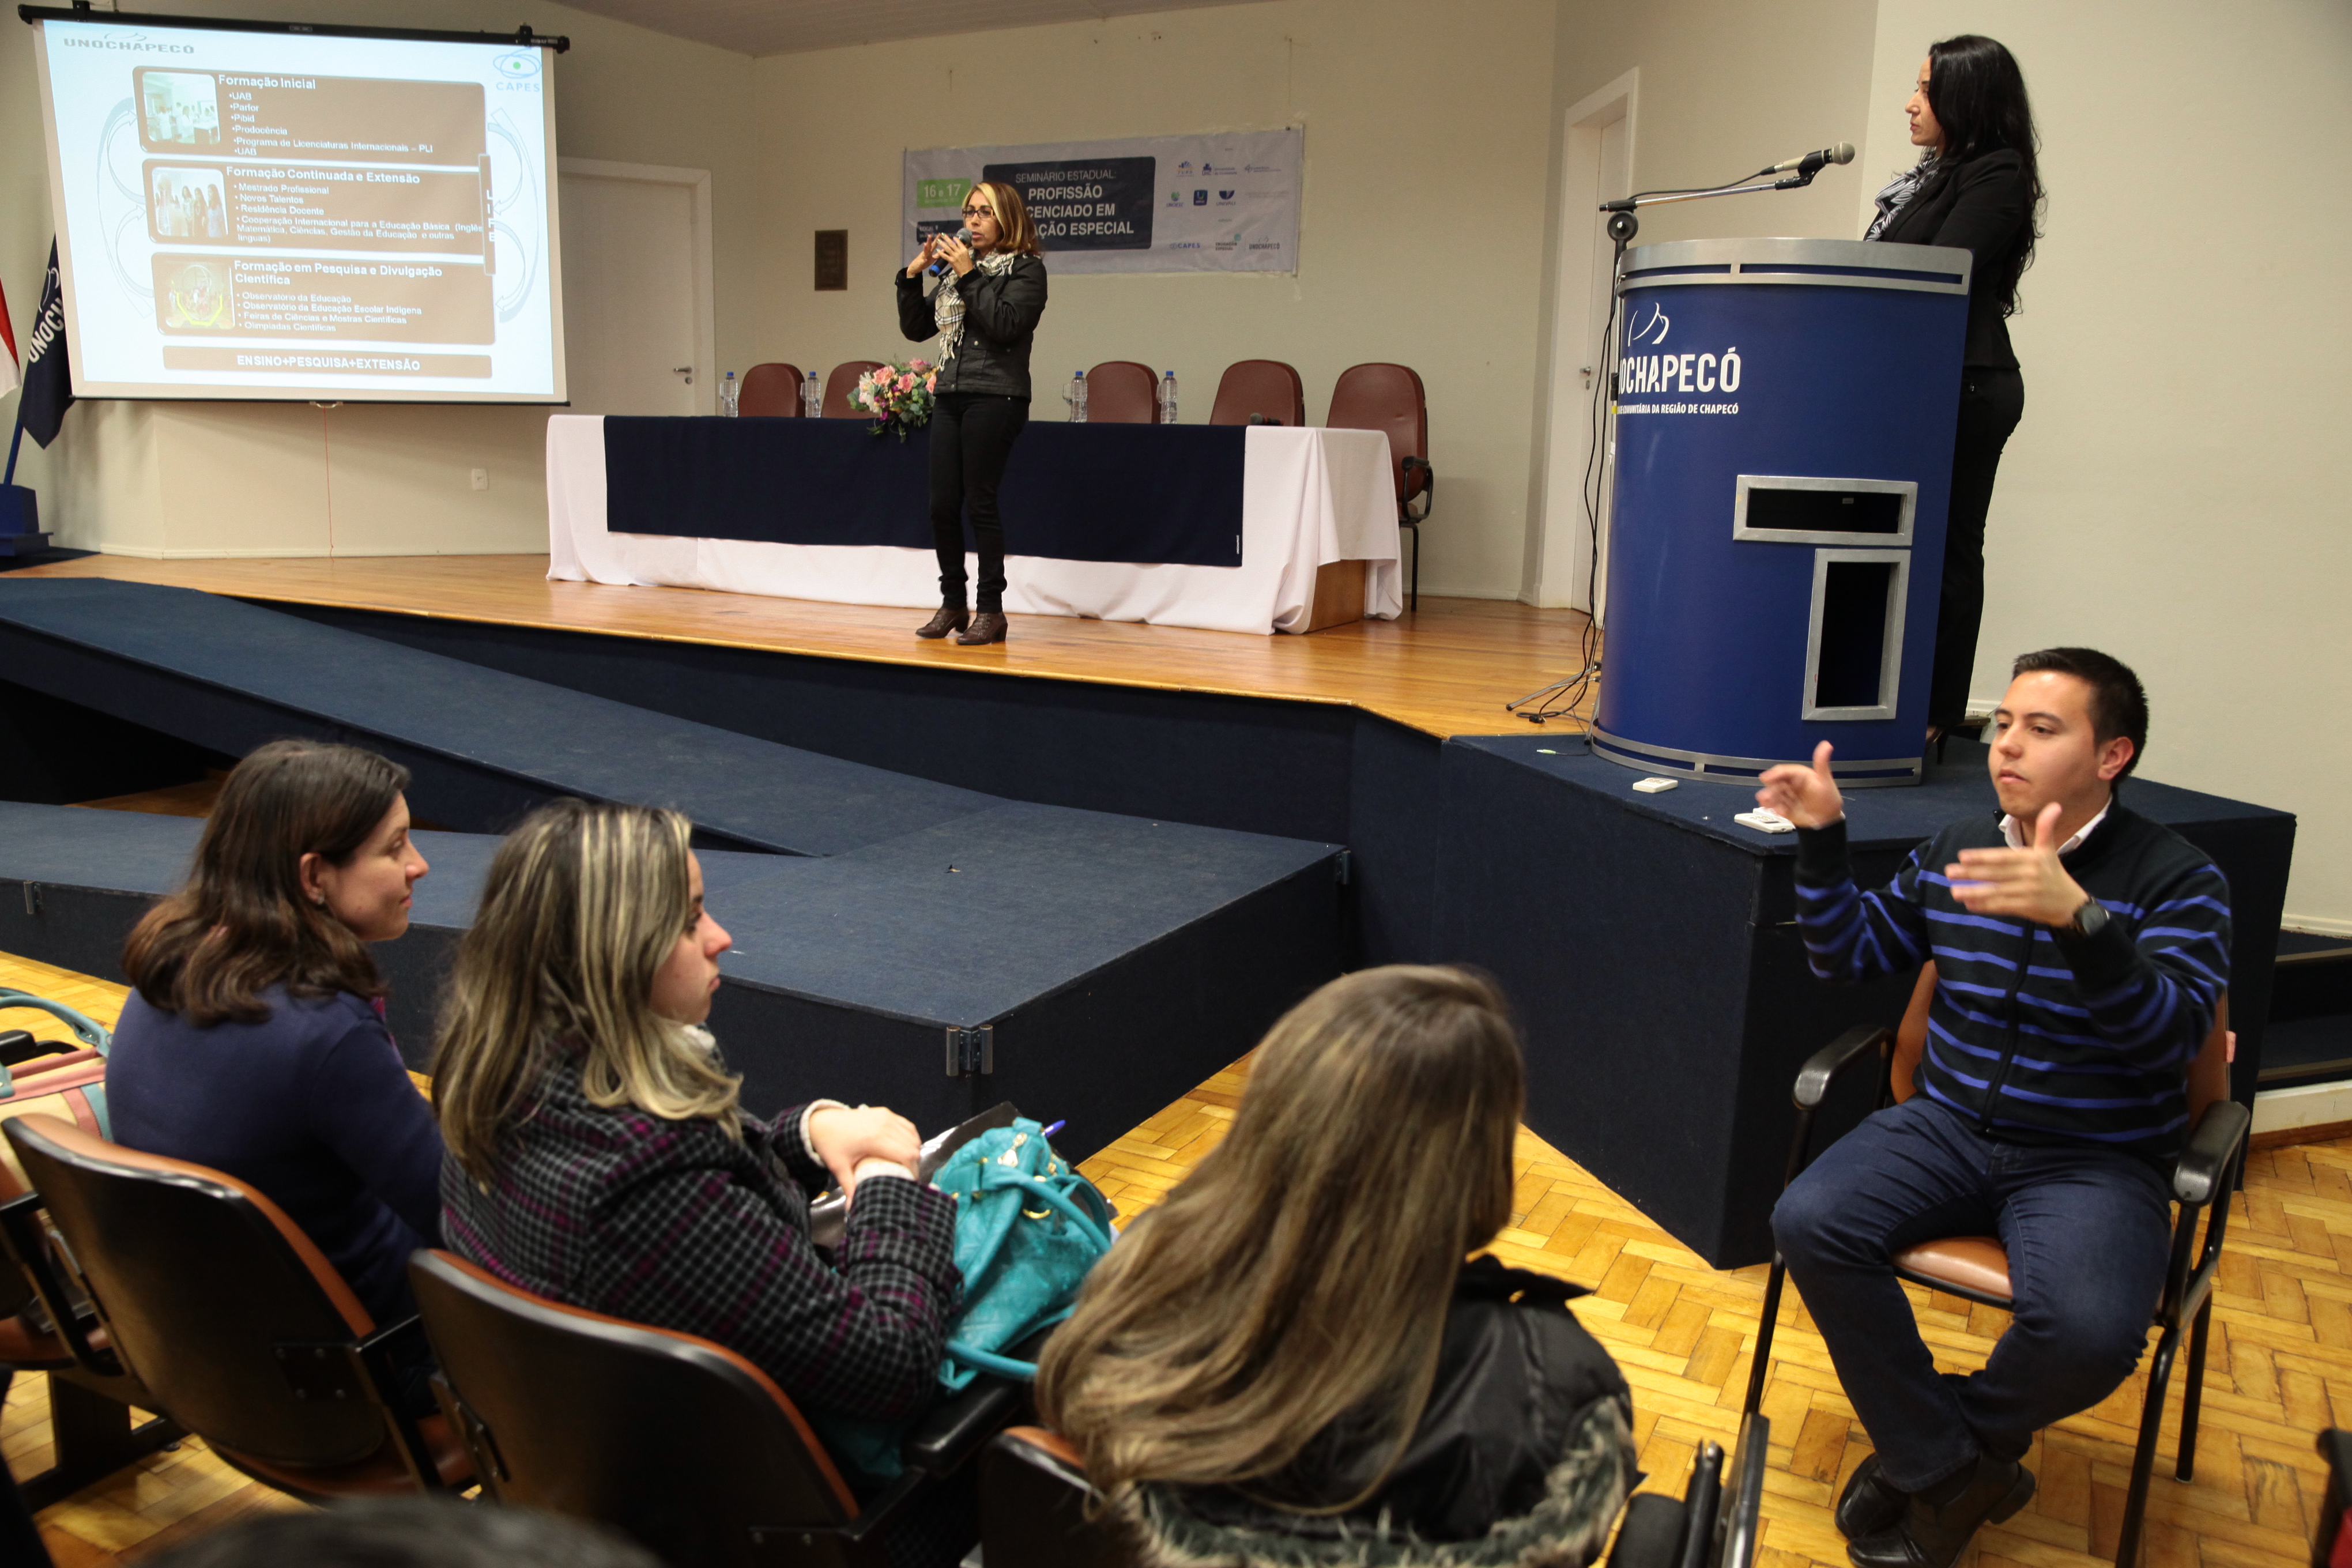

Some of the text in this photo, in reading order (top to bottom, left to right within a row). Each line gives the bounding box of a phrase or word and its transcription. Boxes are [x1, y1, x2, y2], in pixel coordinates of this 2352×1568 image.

[63, 38, 195, 54] UNOCHAPECÓ
[218, 74, 316, 89] Formação Inicial
[496, 81, 540, 92] CAPES
[232, 92, 252, 101] UAB
[233, 103, 259, 112] Parfor
[234, 114, 255, 123] Pibid
[235, 125, 288, 135] Prodocência
[236, 137, 278, 148] Programa
[280, 139, 291, 147] de
[293, 140, 349, 150] Licenciaturas
[351, 142, 409, 152] Internacionais
[419, 144, 433, 153] PLI
[238, 148, 257, 156] UAB
[226, 166, 286, 180] Formação
[288, 168, 354, 182] Continuada
[366, 172, 421, 184] Extensão
[1015, 169, 1116, 183] SEMINÁRIO ESTADUAL:
[239, 182, 329, 195] Mestrado Profissional
[924, 184, 936, 197] 16
[947, 183, 961, 197] 17
[1028, 183, 1103, 201] PROFISSÃO
[240, 193, 304, 205] Novos Talentos
[241, 203, 324, 216] Residência Docente
[1096, 203, 1115, 216] EM
[241, 215, 293, 226] Cooperação
[295, 217, 348, 228] Internacional
[379, 220, 421, 231] Educação
[423, 222, 450, 231] Básica
[1070, 221, 1134, 236] ESPECIAL
[331, 227, 360, 236] Gestão
[376, 229, 417, 240] Educação
[234, 259, 443, 278] Formação em Pesquisa e Divulgação
[242, 291, 296, 301] Observatório
[310, 293, 352, 304] Educação
[243, 301, 297, 312] Observatório
[299, 304, 308, 312] da
[311, 303, 352, 314] Educação
[355, 304, 384, 314] Escolar
[243, 311, 270, 320] Feiras
[272, 313, 282, 321] de
[285, 312, 320, 322] Ciências
[330, 314, 363, 323] Mostras
[237, 355, 420, 371] ENSINO+PESQUISA+EXTENSÃO
[1651, 404, 1660, 414] DA
[1661, 402, 1686, 414] REGIÃO
[1688, 404, 1698, 414] DE
[1699, 402, 1739, 414] CHAPECÓ
